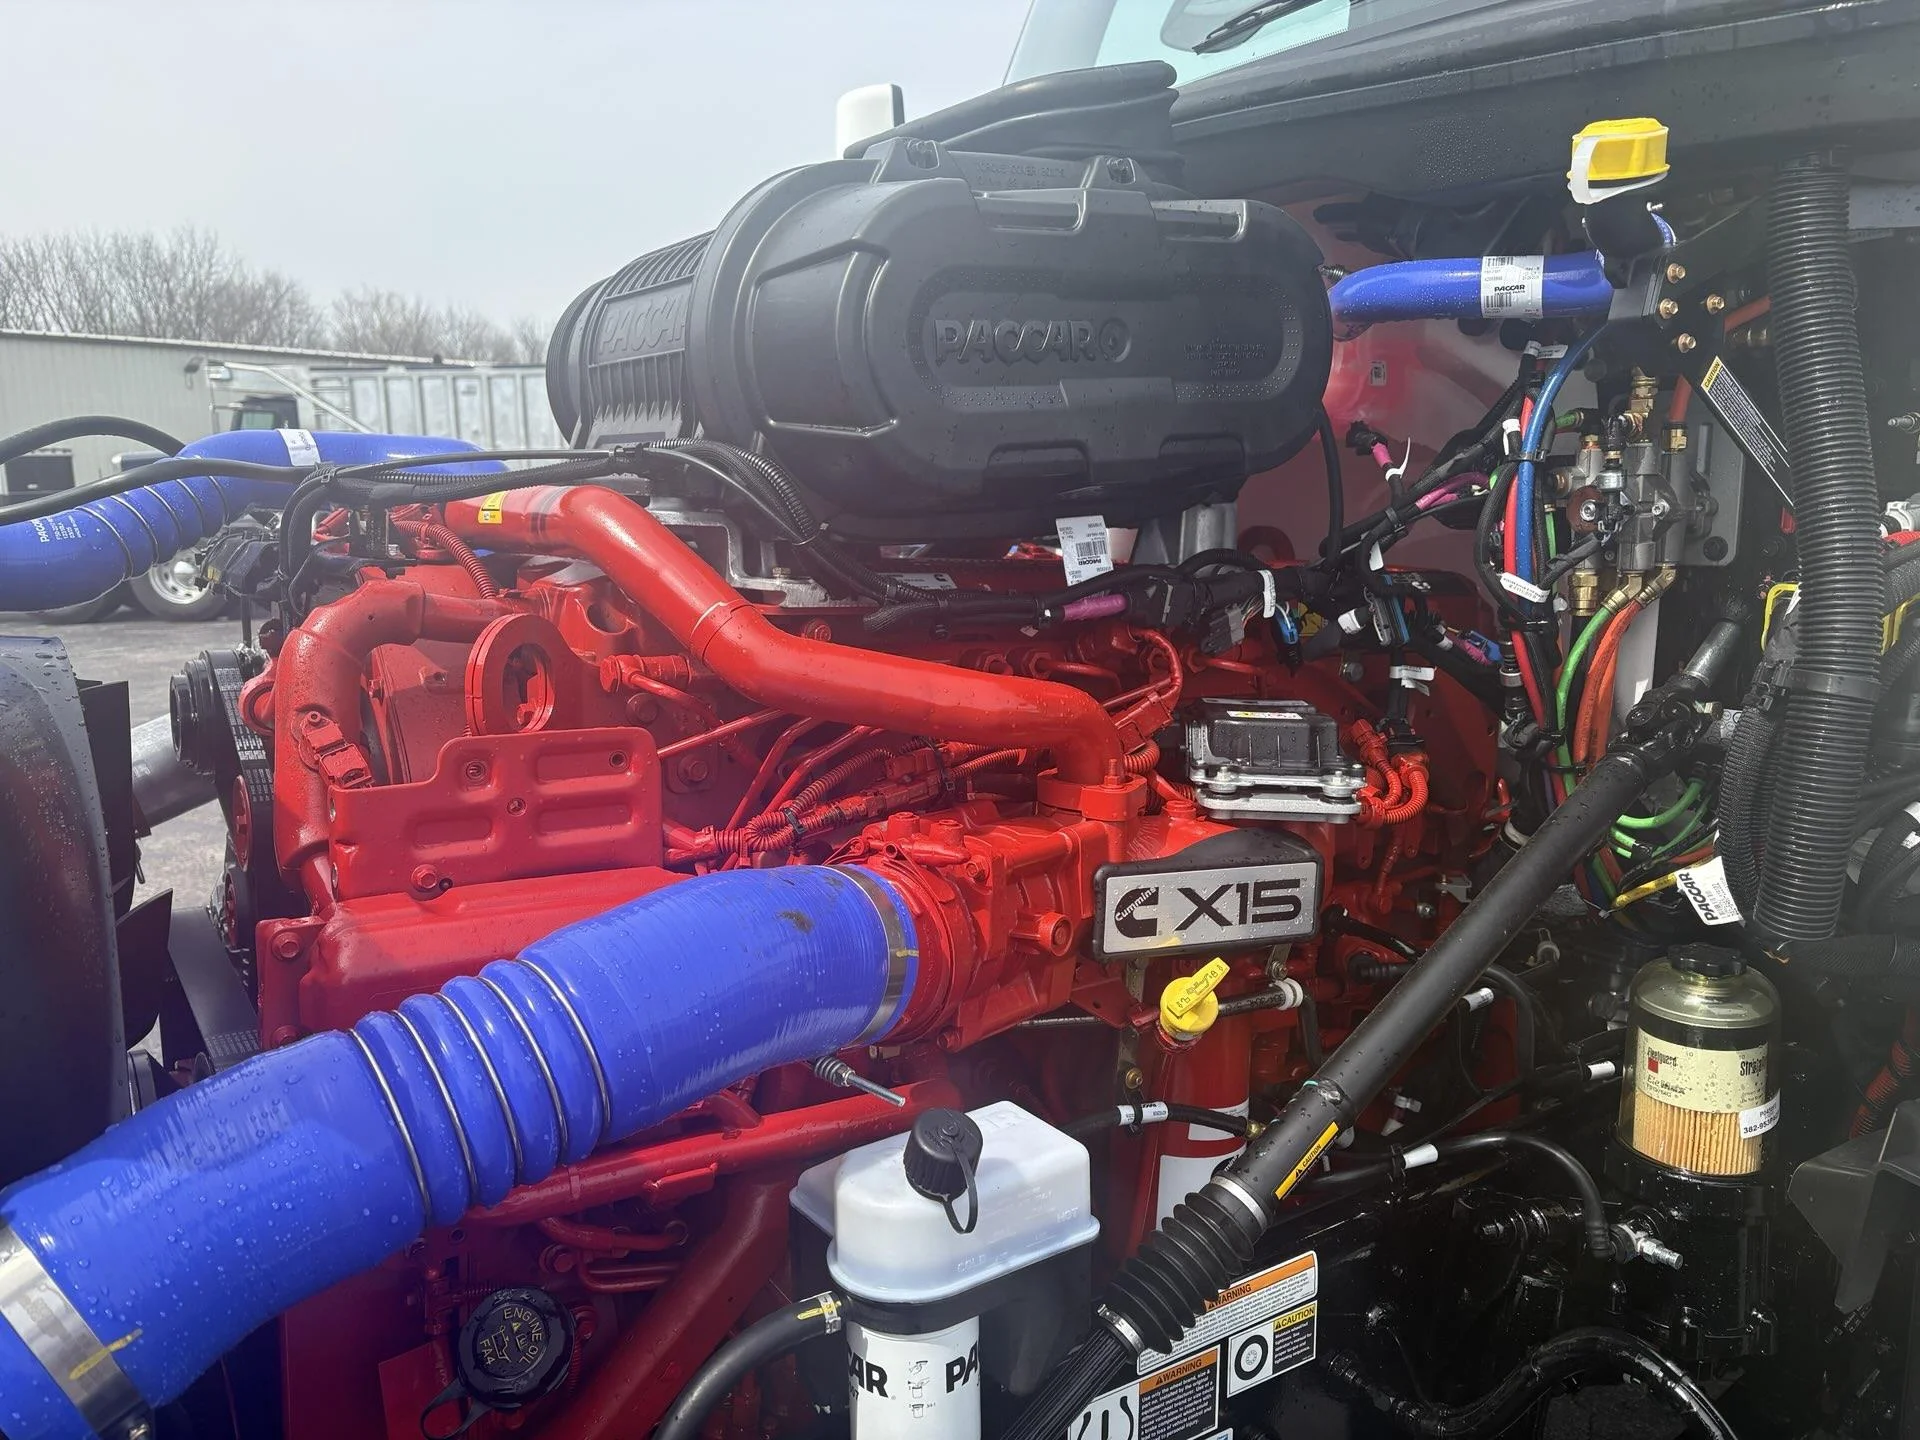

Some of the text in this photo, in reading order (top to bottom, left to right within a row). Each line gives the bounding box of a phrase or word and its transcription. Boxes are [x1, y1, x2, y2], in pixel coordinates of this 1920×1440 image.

[1494, 284, 1526, 293] PACCAR
[934, 319, 1097, 366] PACCAR
[1704, 361, 1720, 388] CAUTION
[1115, 886, 1158, 922] Cummins
[1173, 879, 1303, 931] X15
[1679, 872, 1719, 921] PACCAR
[1303, 1144, 1322, 1167] CAUTION
[1282, 1307, 1315, 1327] CAUTION
[503, 1307, 542, 1365] ENGINE OIL
[480, 1338, 496, 1366] FA4
[1161, 1359, 1202, 1382] WARNING
